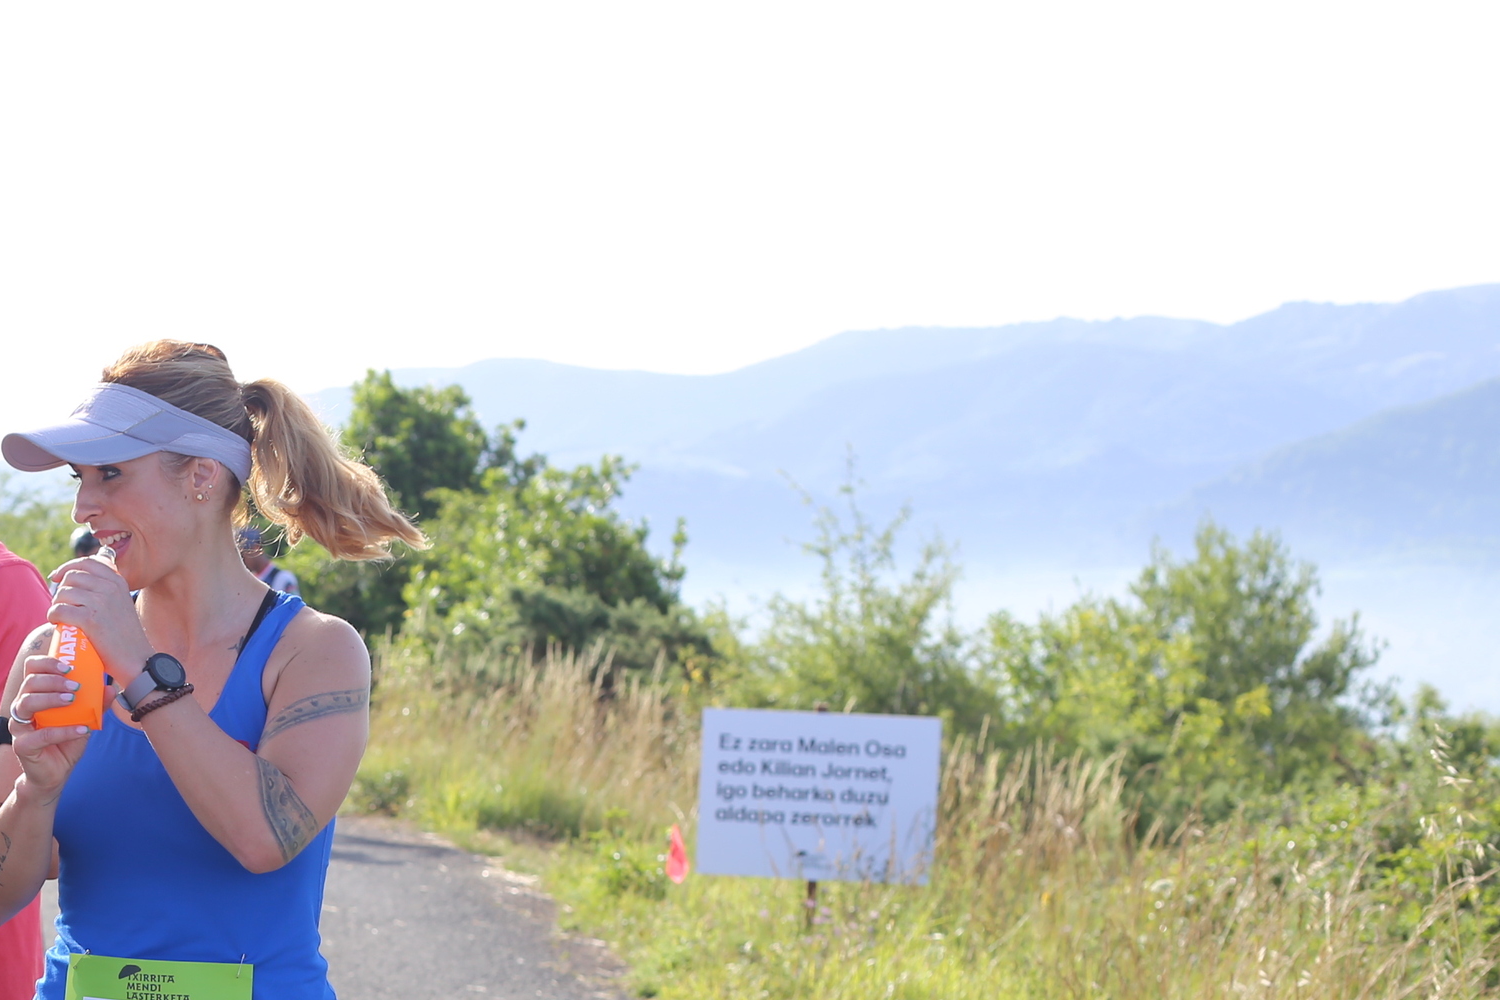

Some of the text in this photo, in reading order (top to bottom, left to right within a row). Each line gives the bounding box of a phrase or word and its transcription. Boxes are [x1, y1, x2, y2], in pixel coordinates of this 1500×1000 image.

[719, 733, 906, 758] Ez zara Malen Osa
[718, 758, 892, 784] edo Kilian Jornet,
[716, 781, 748, 802] igo
[840, 787, 889, 806] duzu
[715, 806, 785, 826] aldapa
[126, 982, 161, 992] MENDI
